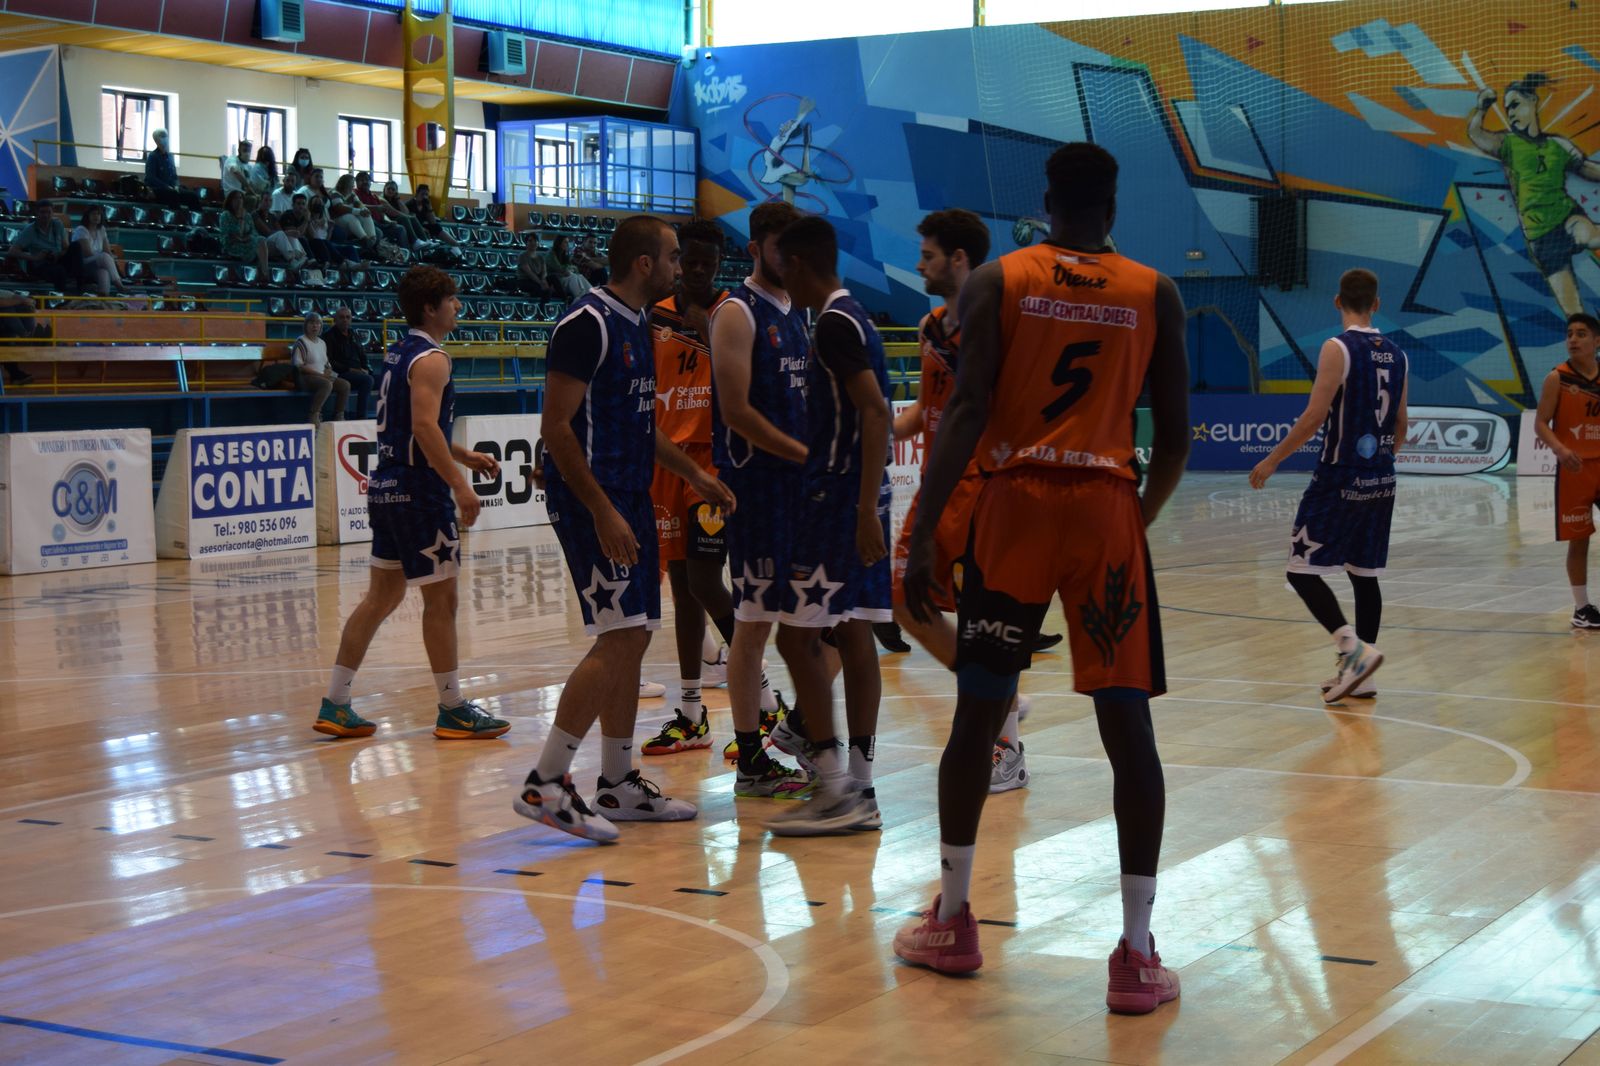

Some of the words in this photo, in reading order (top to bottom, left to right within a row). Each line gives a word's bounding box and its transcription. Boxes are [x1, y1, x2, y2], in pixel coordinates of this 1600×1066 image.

[1054, 302, 1100, 322] CENTRAL
[677, 349, 698, 375] 14
[1041, 341, 1102, 423] 5
[676, 399, 709, 410] Bilbao
[1375, 368, 1389, 427] 5
[194, 437, 311, 467] ASESORIA
[1062, 451, 1119, 468] RURAL
[1439, 456, 1494, 464] MAQUINARIA
[52, 479, 118, 518] C&M
[194, 467, 311, 511] CONTA
[384, 492, 411, 503] Reina
[214, 519, 236, 537] Tel.:
[238, 518, 257, 535] 980
[259, 517, 279, 532] 536
[280, 516, 297, 530] 096
[200, 535, 309, 554] asesoriaconta@hotmail.com
[756, 557, 775, 578] 10
